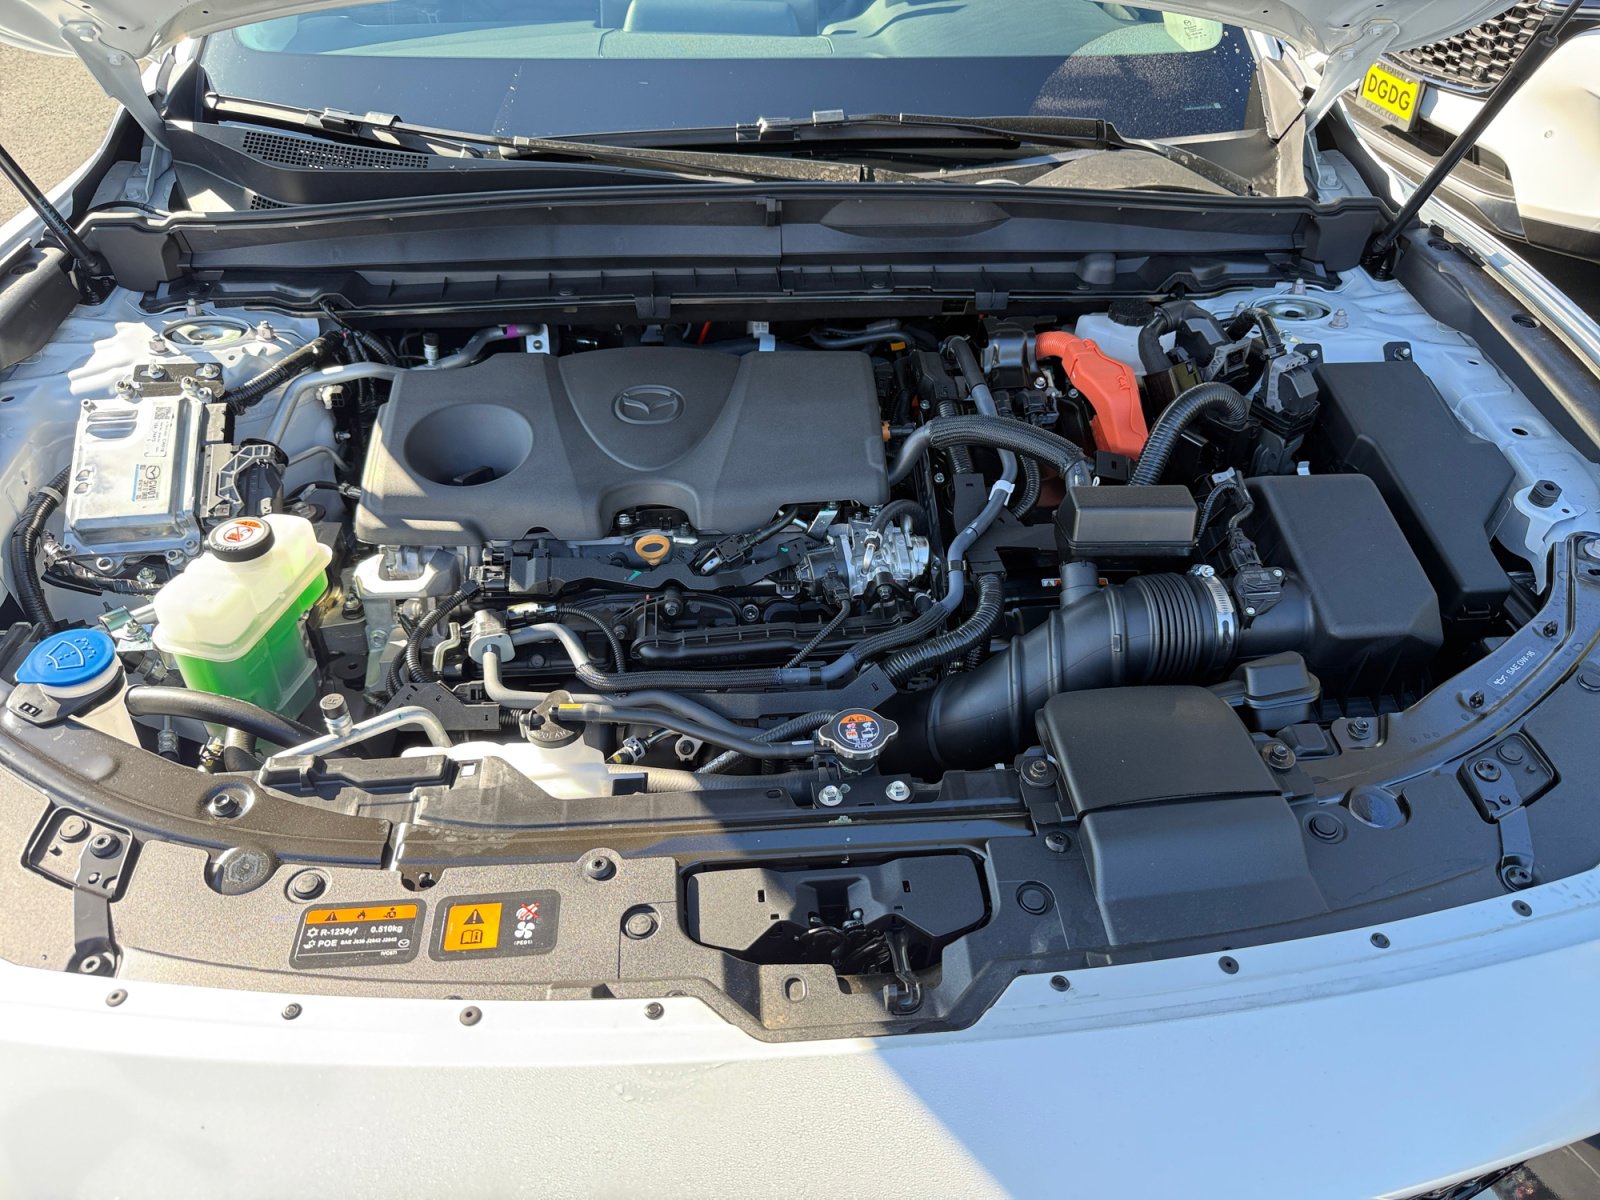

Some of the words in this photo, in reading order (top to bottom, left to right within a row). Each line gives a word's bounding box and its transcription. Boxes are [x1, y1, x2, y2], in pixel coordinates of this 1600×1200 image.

[1367, 73, 1411, 111] DGDG
[37, 197, 70, 235] STABILUS
[1506, 663, 1521, 676] SAE
[320, 927, 359, 937] R-1234yf
[370, 925, 403, 933] 0.510kg
[317, 939, 338, 948] POE
